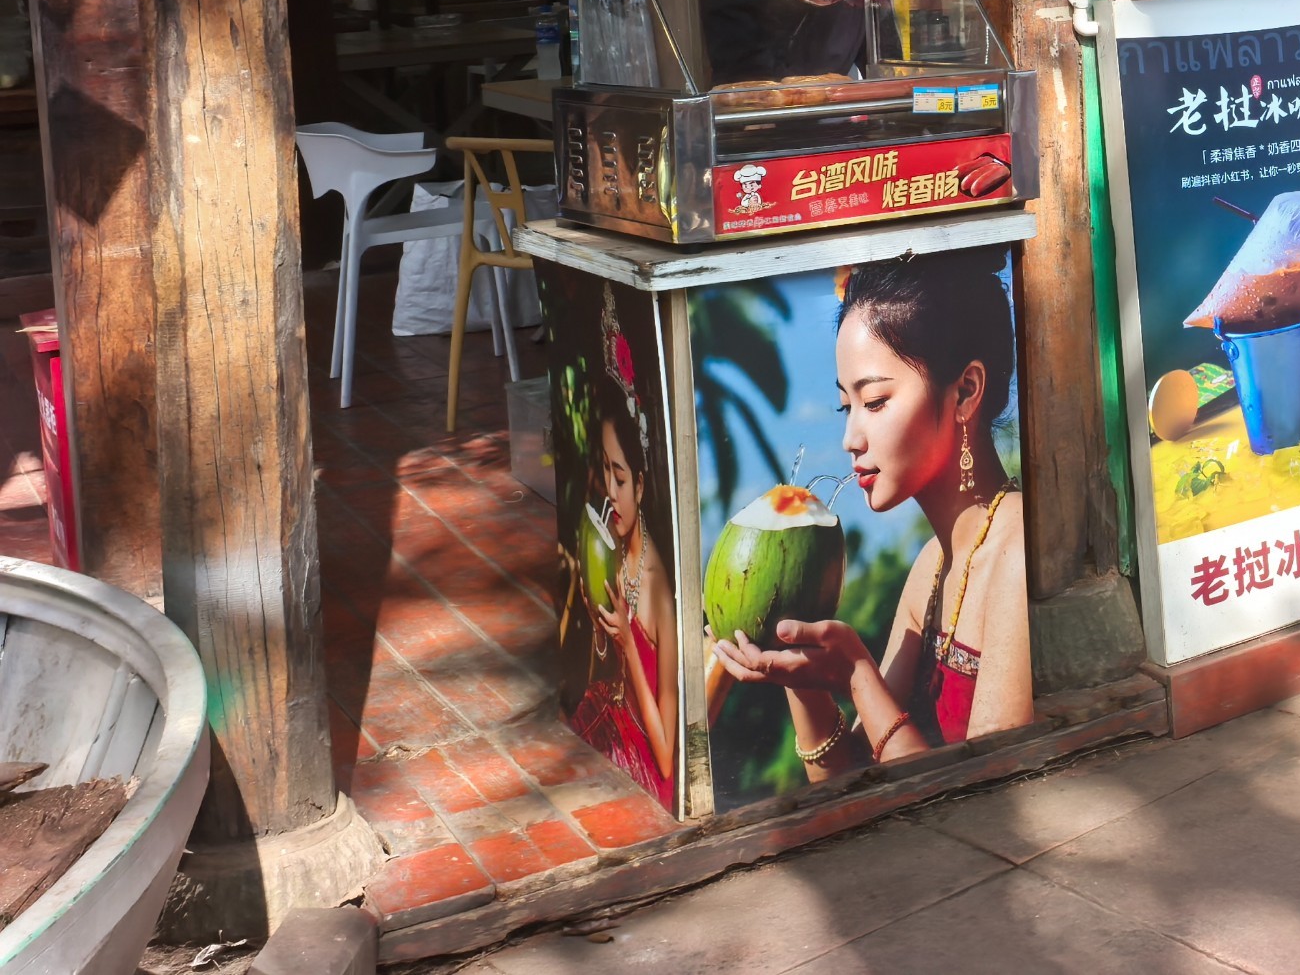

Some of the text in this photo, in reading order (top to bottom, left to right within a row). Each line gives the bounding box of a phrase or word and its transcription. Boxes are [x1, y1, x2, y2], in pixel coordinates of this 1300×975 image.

[790, 150, 899, 201] 台湾风味
[881, 169, 959, 209] 烤香肠
